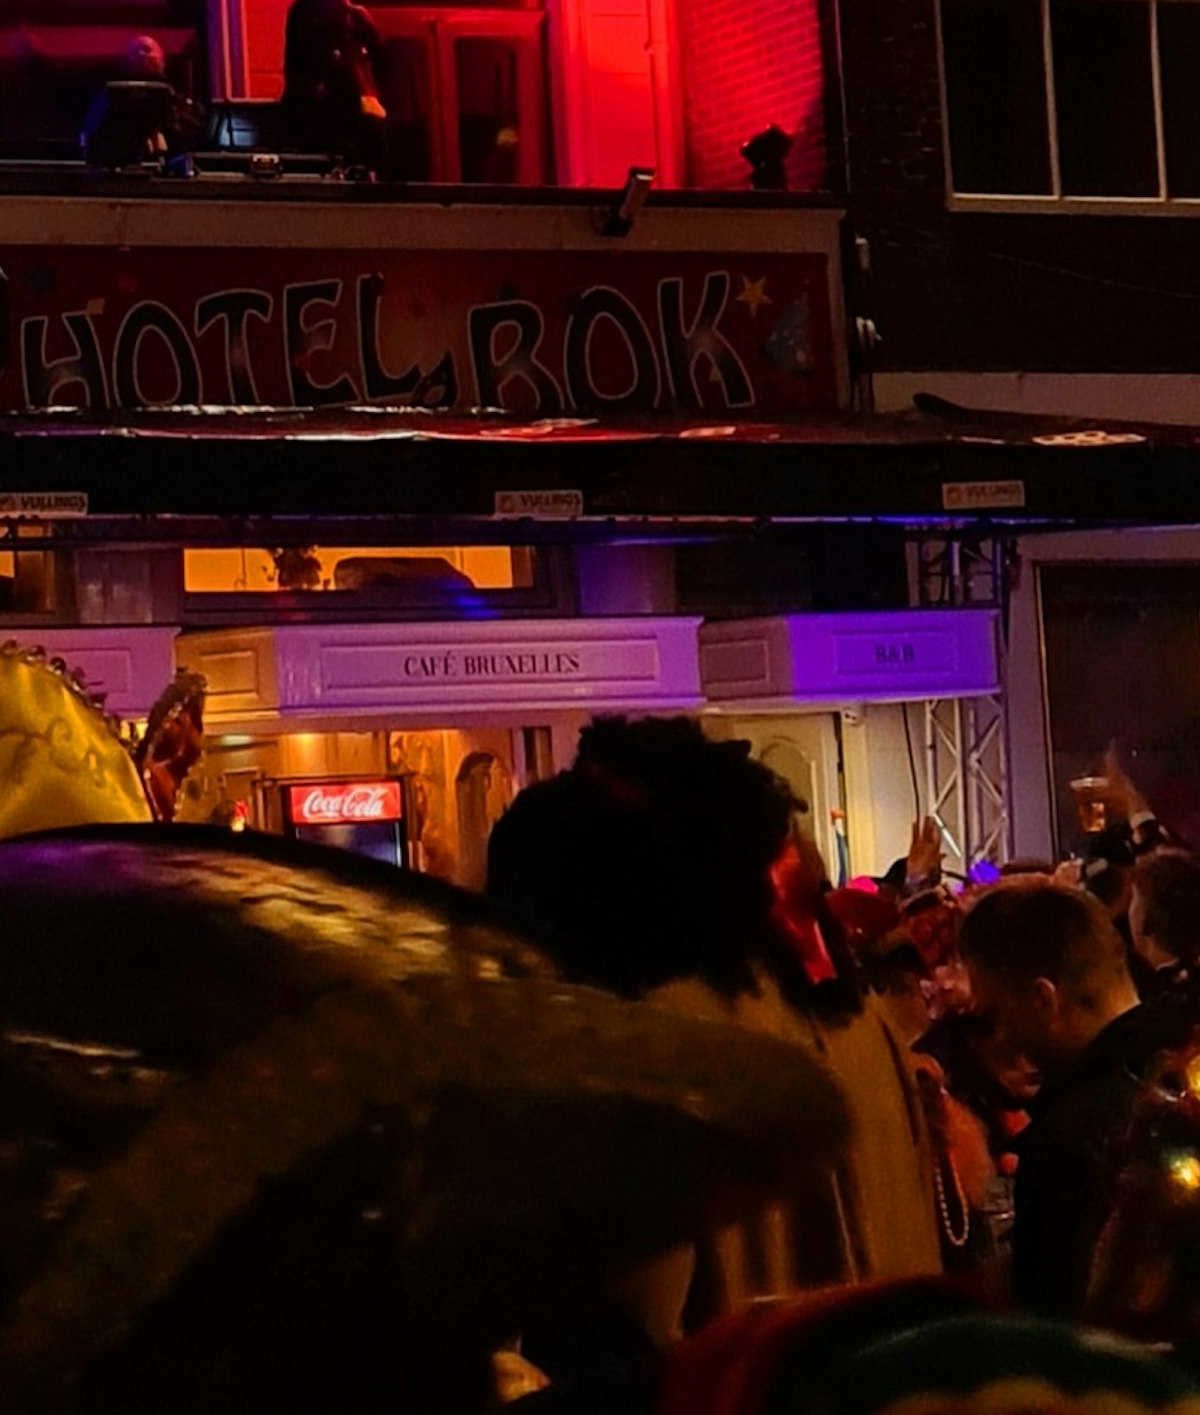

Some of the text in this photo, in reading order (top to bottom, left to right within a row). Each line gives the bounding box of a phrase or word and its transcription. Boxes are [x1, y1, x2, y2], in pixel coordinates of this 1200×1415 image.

[20, 272, 422, 408] HOTEL
[404, 650, 579, 676] CAFÉ BRUXELLES
